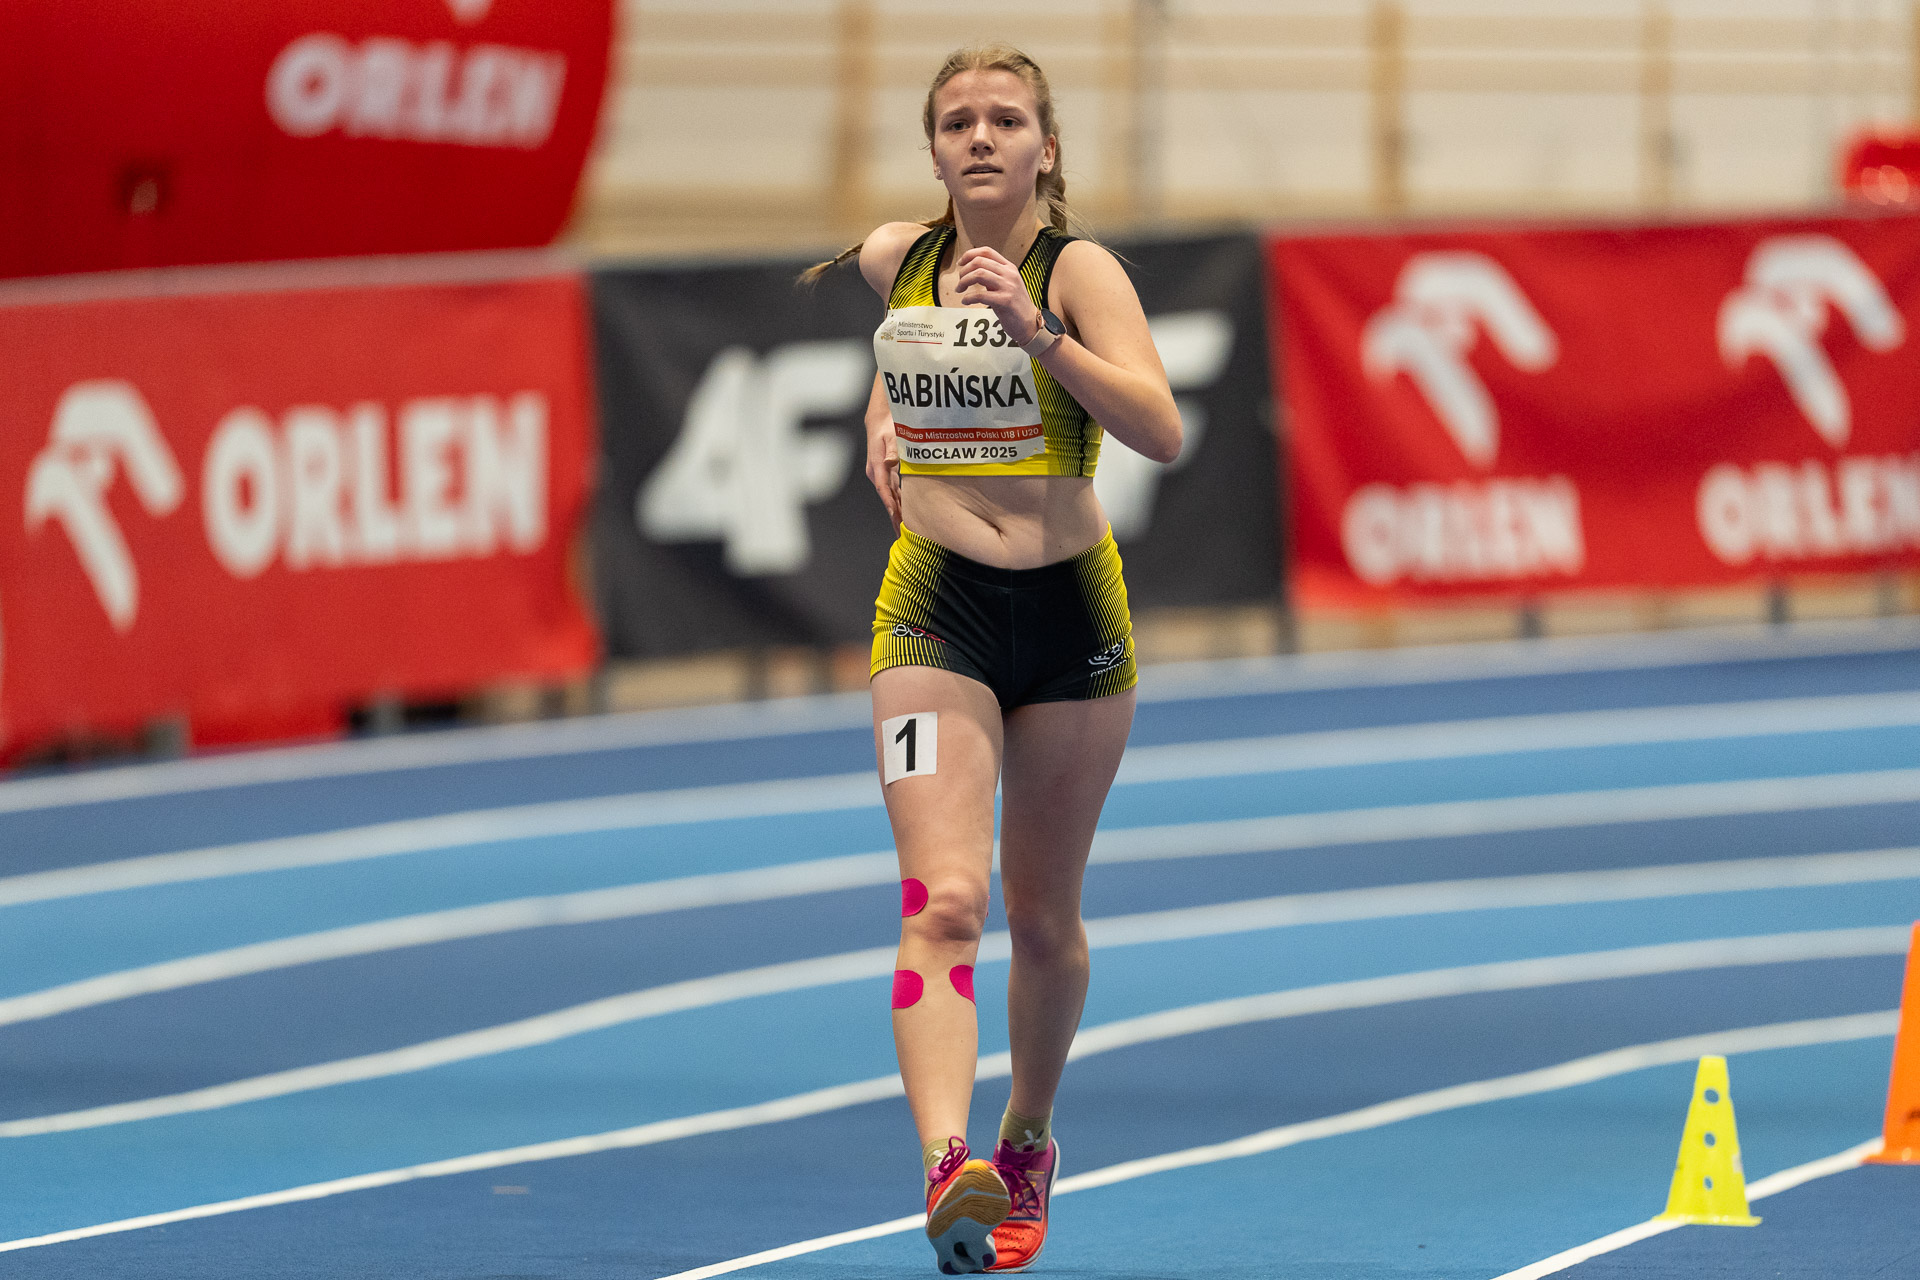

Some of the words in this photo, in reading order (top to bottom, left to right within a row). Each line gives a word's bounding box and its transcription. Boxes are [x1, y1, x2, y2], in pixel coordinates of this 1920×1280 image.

[265, 33, 567, 150] ORLEN
[896, 329, 914, 337] Sportu
[918, 330, 945, 339] Turystyki
[898, 321, 934, 330] Ministerstwo
[884, 367, 1034, 408] BABIŃSKA
[906, 446, 977, 459] WROCŁAW
[980, 446, 1018, 458] 2025
[1000, 430, 1015, 438] U18
[1022, 428, 1039, 436] U20
[637, 336, 876, 577] 4F
[203, 391, 550, 577] ORLEN
[895, 718, 917, 772] 1
